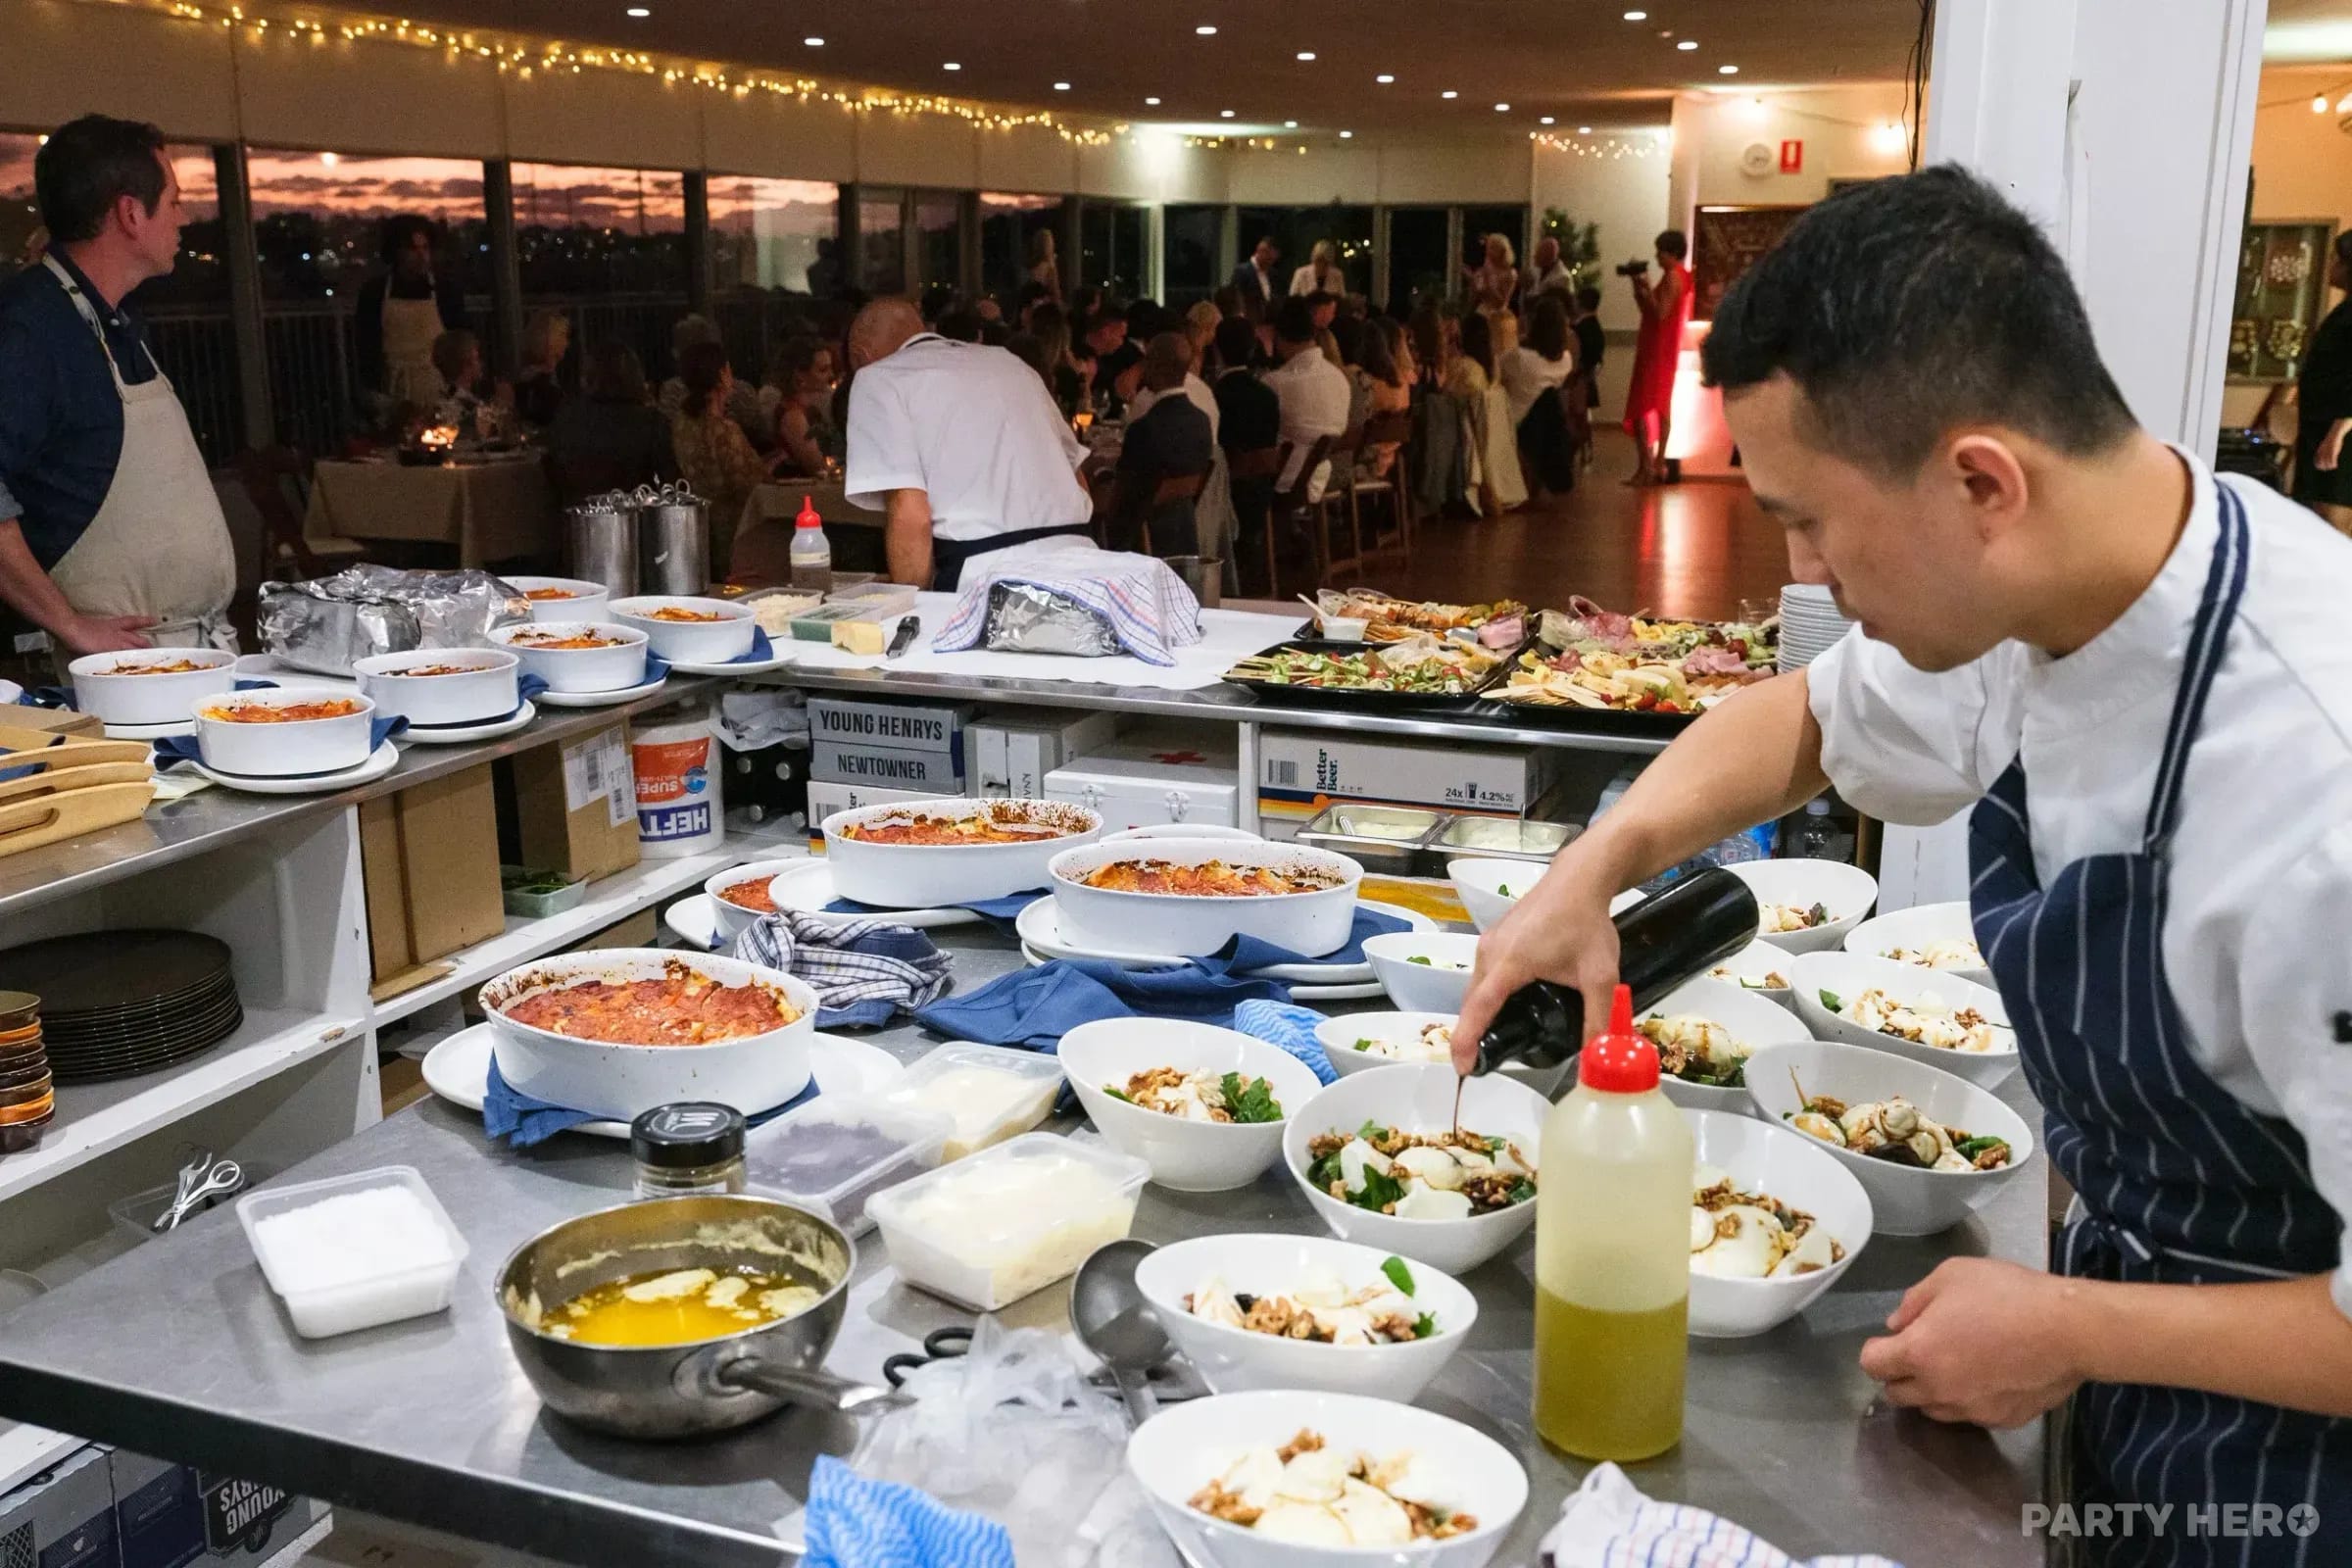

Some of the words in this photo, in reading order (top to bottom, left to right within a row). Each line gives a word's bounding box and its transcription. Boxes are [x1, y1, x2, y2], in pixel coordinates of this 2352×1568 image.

[819, 710, 874, 734] YOUNG
[879, 715, 943, 741] HENRYS
[838, 755, 926, 780] NEWTOWNER
[1316, 748, 1327, 791] Better
[1445, 787, 1463, 799] 24x
[1479, 791, 1505, 802] 4.2%
